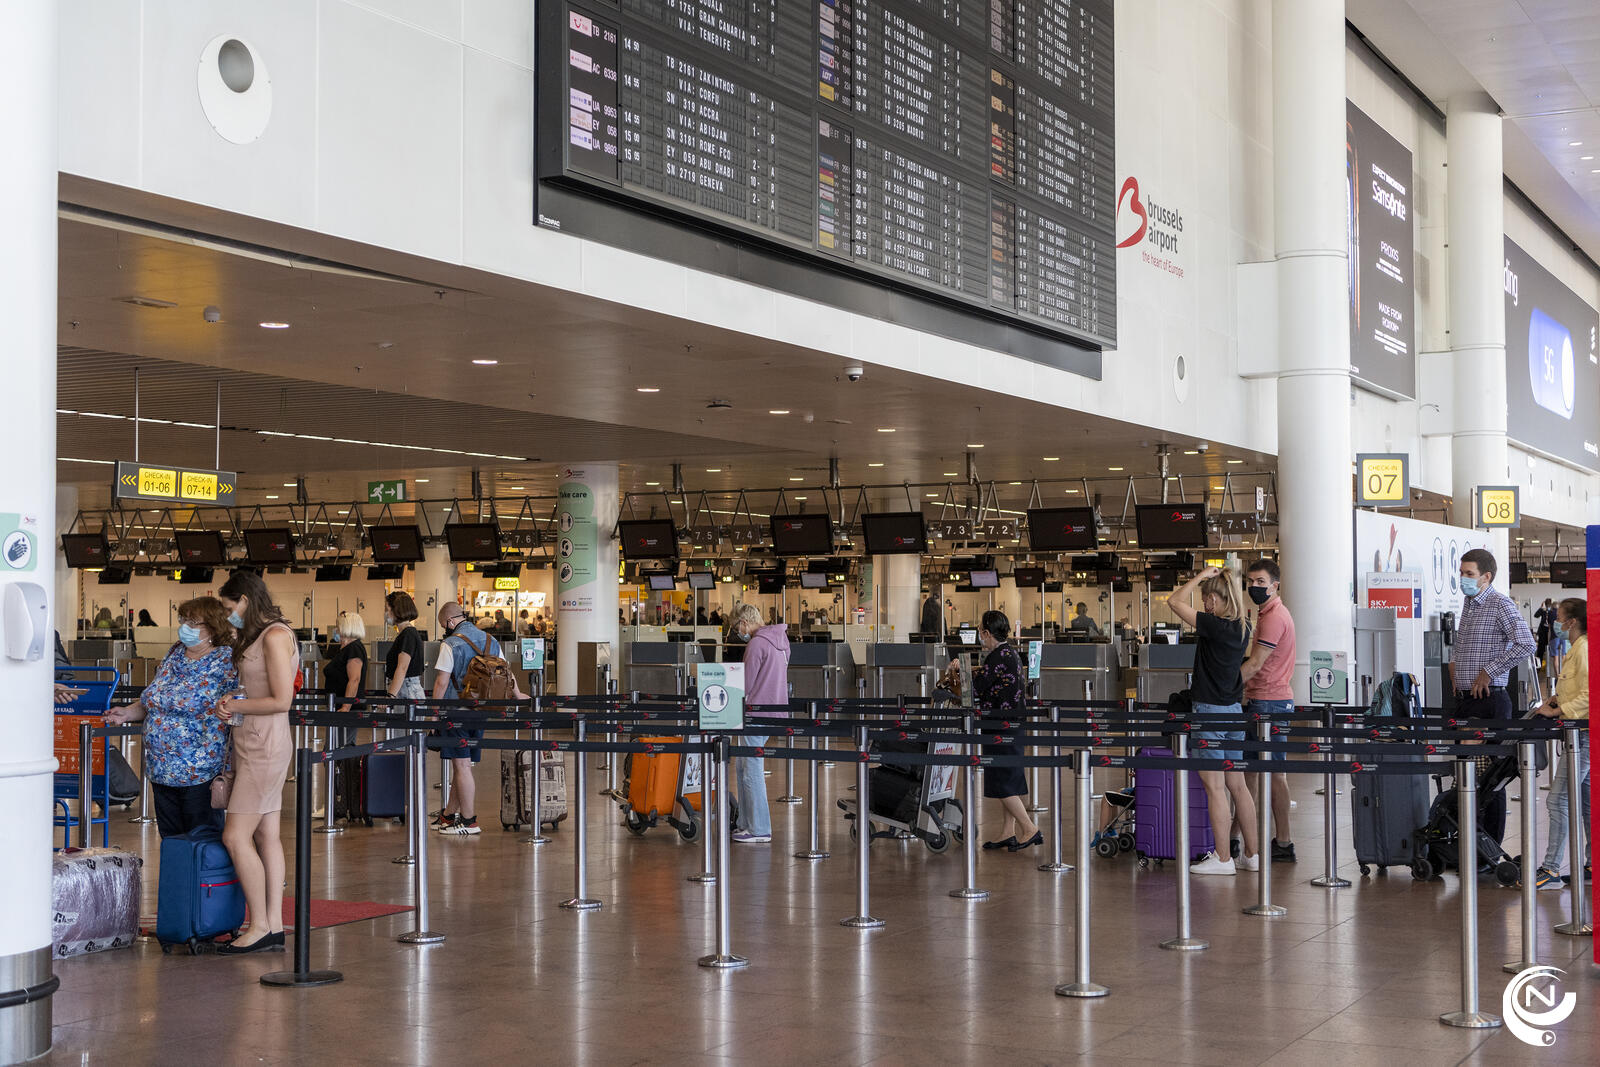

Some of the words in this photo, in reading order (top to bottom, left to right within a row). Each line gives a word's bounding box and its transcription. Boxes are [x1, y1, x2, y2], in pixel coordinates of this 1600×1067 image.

[679, 0, 694, 17] 1751
[699, 8, 715, 27] GRAN
[718, 18, 745, 42] CANARIA
[592, 24, 599, 37] TB
[603, 29, 616, 45] 2161
[700, 26, 730, 52] TENERIFE
[907, 23, 923, 40] DUBLIN
[884, 39, 891, 50] KL
[907, 52, 931, 73] AMSTERDAM
[907, 37, 931, 59] STOCKHOLM
[592, 61, 600, 75] AC
[603, 66, 617, 82] 6338
[666, 55, 674, 69] TB
[678, 60, 694, 78] 2161
[700, 69, 734, 95] ZAKINTHOS
[822, 70, 832, 80] LOT
[907, 66, 923, 83] MADRID
[700, 87, 719, 105] CORFU
[907, 81, 921, 96] MILAN
[592, 99, 600, 113] UA
[666, 90, 675, 105] SN
[682, 97, 695, 113] 319
[700, 104, 719, 123] ACCRA
[907, 95, 929, 114] ISTANBUL
[592, 118, 599, 131] EY
[907, 110, 923, 125] WARSAW
[700, 121, 727, 143] ABIDJAN
[907, 125, 923, 140] MADRID
[592, 138, 600, 150] UA
[666, 125, 675, 140] SN
[679, 130, 695, 148] 3181
[700, 138, 715, 155] ROME
[719, 146, 731, 161] FCO
[666, 144, 675, 158] EY
[683, 150, 695, 165] 058
[700, 156, 711, 171] ABU
[715, 162, 734, 179] DHABI
[666, 162, 675, 176] SN
[679, 166, 695, 183] 2719
[700, 174, 723, 193] GENEVA
[907, 160, 920, 174] ADDIS
[923, 168, 937, 181] ABABA
[1055, 169, 1073, 184] AMSTERDAM
[907, 175, 924, 189] VIENNA
[907, 190, 924, 204] MADRID
[1372, 180, 1405, 221] Samsonite
[907, 204, 923, 218] MALAGA
[1148, 195, 1183, 232] brussels
[907, 219, 923, 232] ZURICH
[907, 233, 921, 245] MILAN
[1148, 222, 1178, 254] airport
[907, 247, 924, 261] ZAGREB
[907, 262, 929, 277] ALICANTE
[1142, 252, 1150, 264] the
[1151, 253, 1162, 269] heart
[1163, 259, 1168, 271] of
[1168, 261, 1184, 278] Europe
[1379, 302, 1390, 316] MADE
[1391, 308, 1402, 322] FROM
[1544, 345, 1554, 384] 5G
[144, 472, 171, 480] CHECK-IN
[188, 476, 212, 484] CHECK-IN
[1369, 474, 1397, 494] 07
[144, 481, 170, 493] 01-06
[187, 485, 211, 496] 07-14
[1487, 502, 1510, 518] 08
[497, 579, 518, 588] Panos
